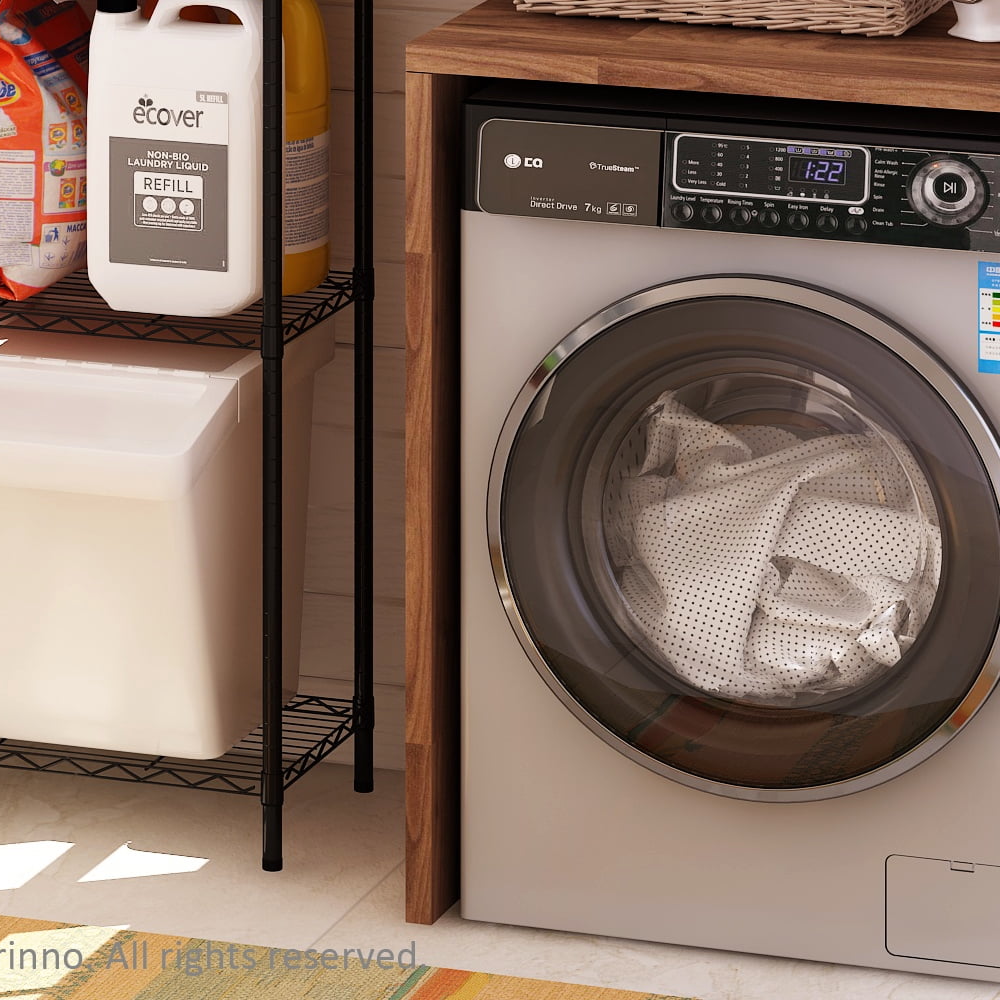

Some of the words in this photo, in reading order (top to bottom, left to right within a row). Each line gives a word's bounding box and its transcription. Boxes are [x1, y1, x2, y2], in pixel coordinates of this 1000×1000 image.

[132, 106, 204, 128] ecover
[146, 150, 190, 162] NON-BIO
[127, 157, 174, 169] LAUNDRY
[175, 162, 209, 172] LIQUID
[804, 161, 843, 182] 1:22
[143, 177, 193, 193] REFILL
[530, 200, 555, 209] Direct
[700, 196, 724, 205] Temperature
[763, 200, 775, 208] Spin
[787, 203, 798, 211] Easy
[820, 205, 834, 213] Delay
